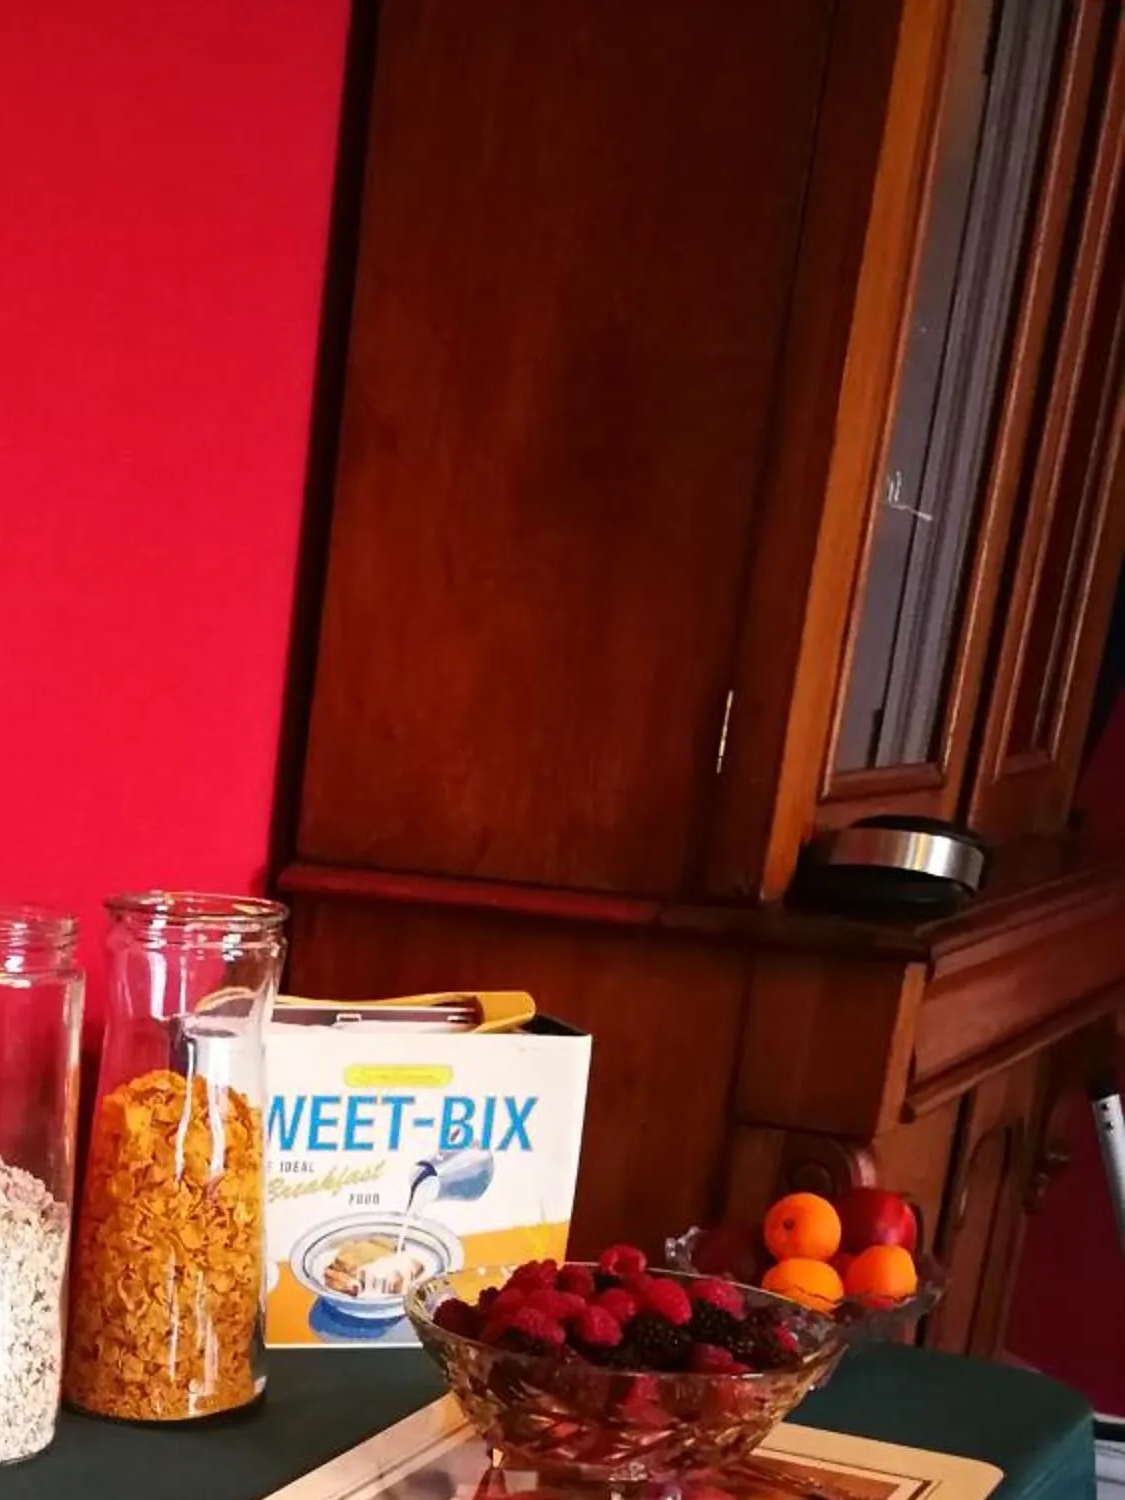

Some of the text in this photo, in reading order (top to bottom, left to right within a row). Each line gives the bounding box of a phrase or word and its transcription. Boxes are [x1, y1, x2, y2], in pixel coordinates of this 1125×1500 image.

[268, 1095, 538, 1151] WEET-BIX
[279, 1161, 315, 1173] IDEAL
[348, 1193, 380, 1205] FOOD
